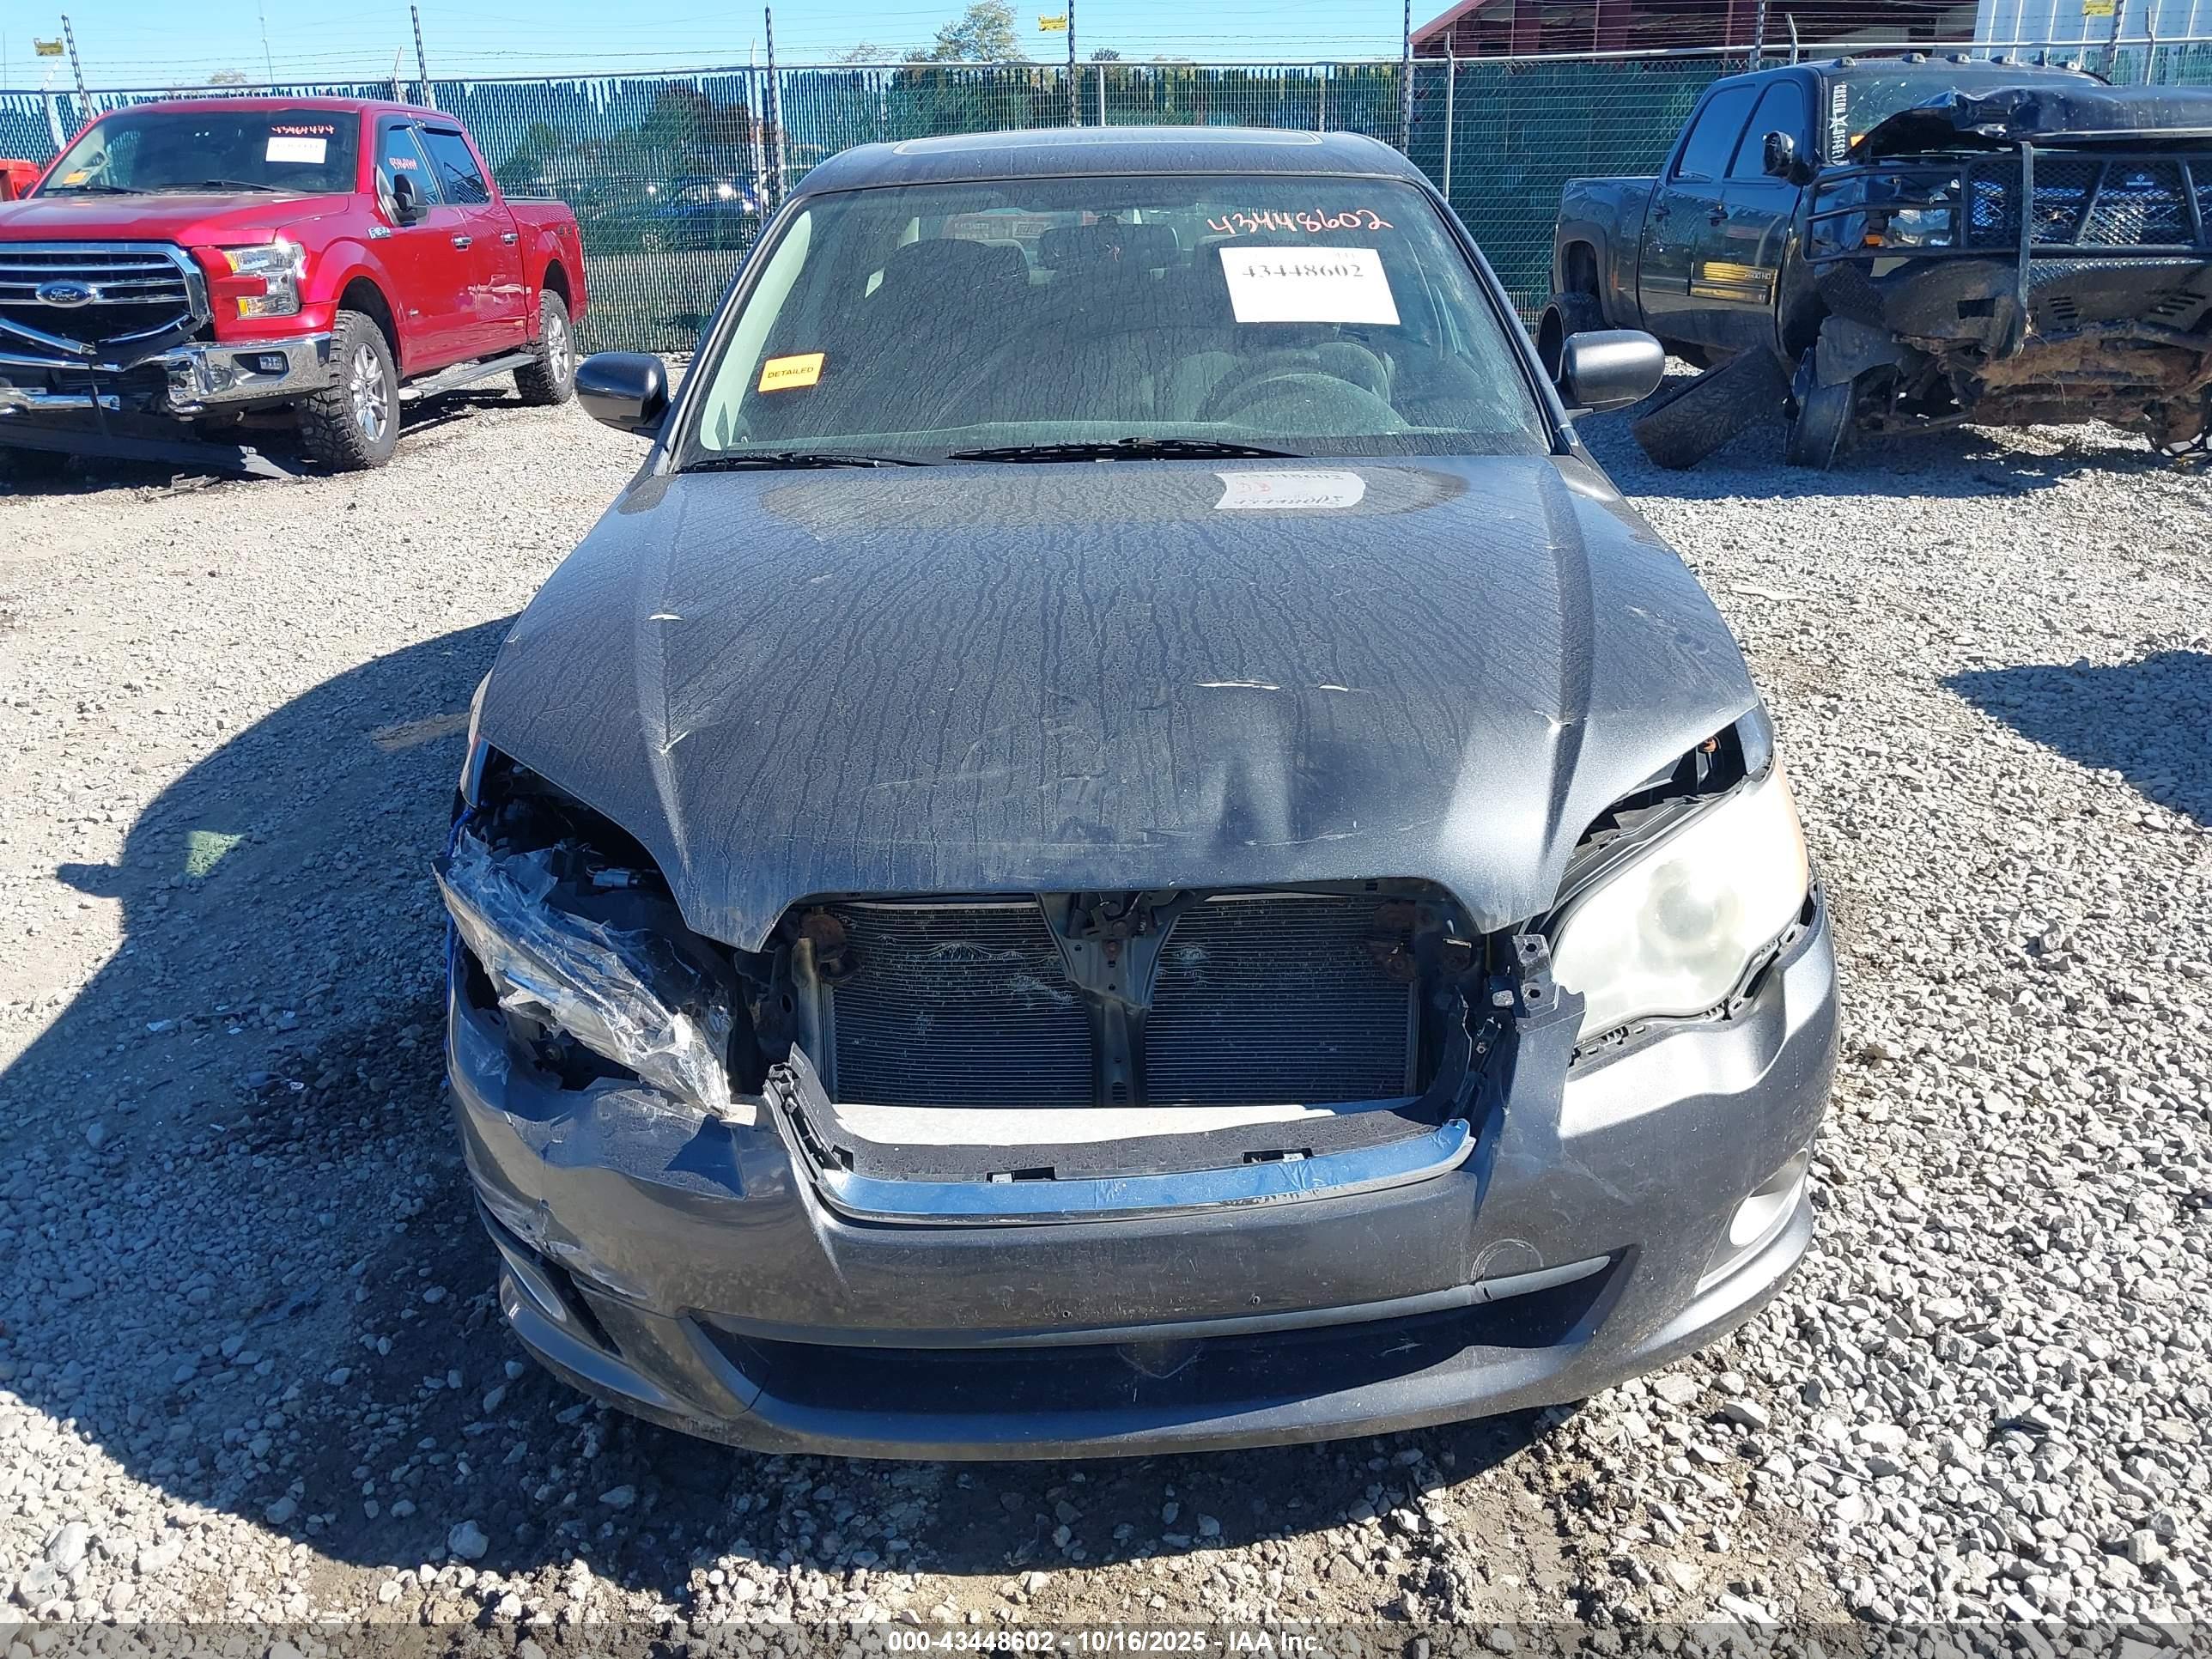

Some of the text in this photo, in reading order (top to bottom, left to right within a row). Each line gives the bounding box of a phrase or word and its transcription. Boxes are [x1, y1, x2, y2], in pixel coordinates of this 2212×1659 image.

[1832, 84, 1847, 113] CUSTOM
[1206, 209, 1395, 234] 43448602
[1242, 264, 1364, 278] 43448602
[49, 288, 78, 301] Ford
[767, 367, 815, 379] DETAILED
